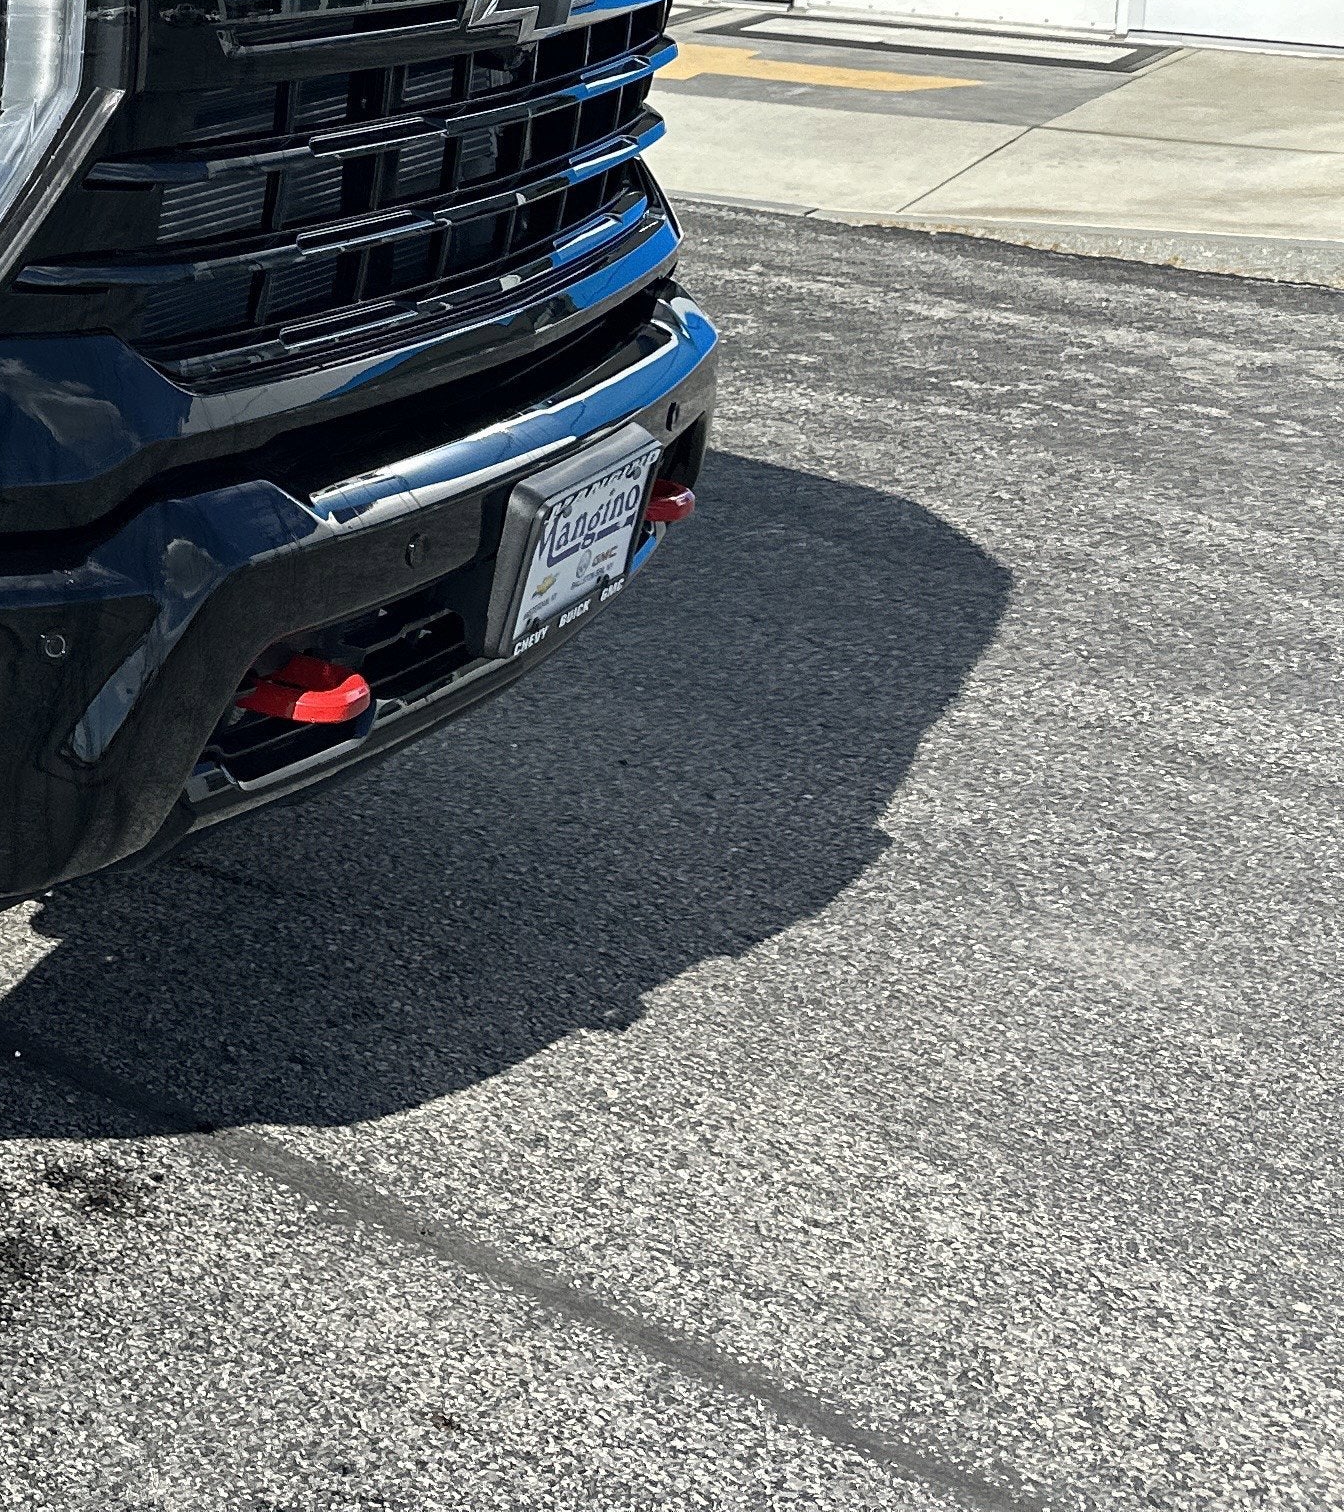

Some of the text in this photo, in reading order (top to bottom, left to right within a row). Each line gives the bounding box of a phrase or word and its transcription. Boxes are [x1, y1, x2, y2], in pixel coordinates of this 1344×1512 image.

[537, 484, 641, 569] Mangino
[513, 625, 550, 656] CHEVY
[558, 599, 592, 628] BUICK
[600, 578, 625, 602] GMC
